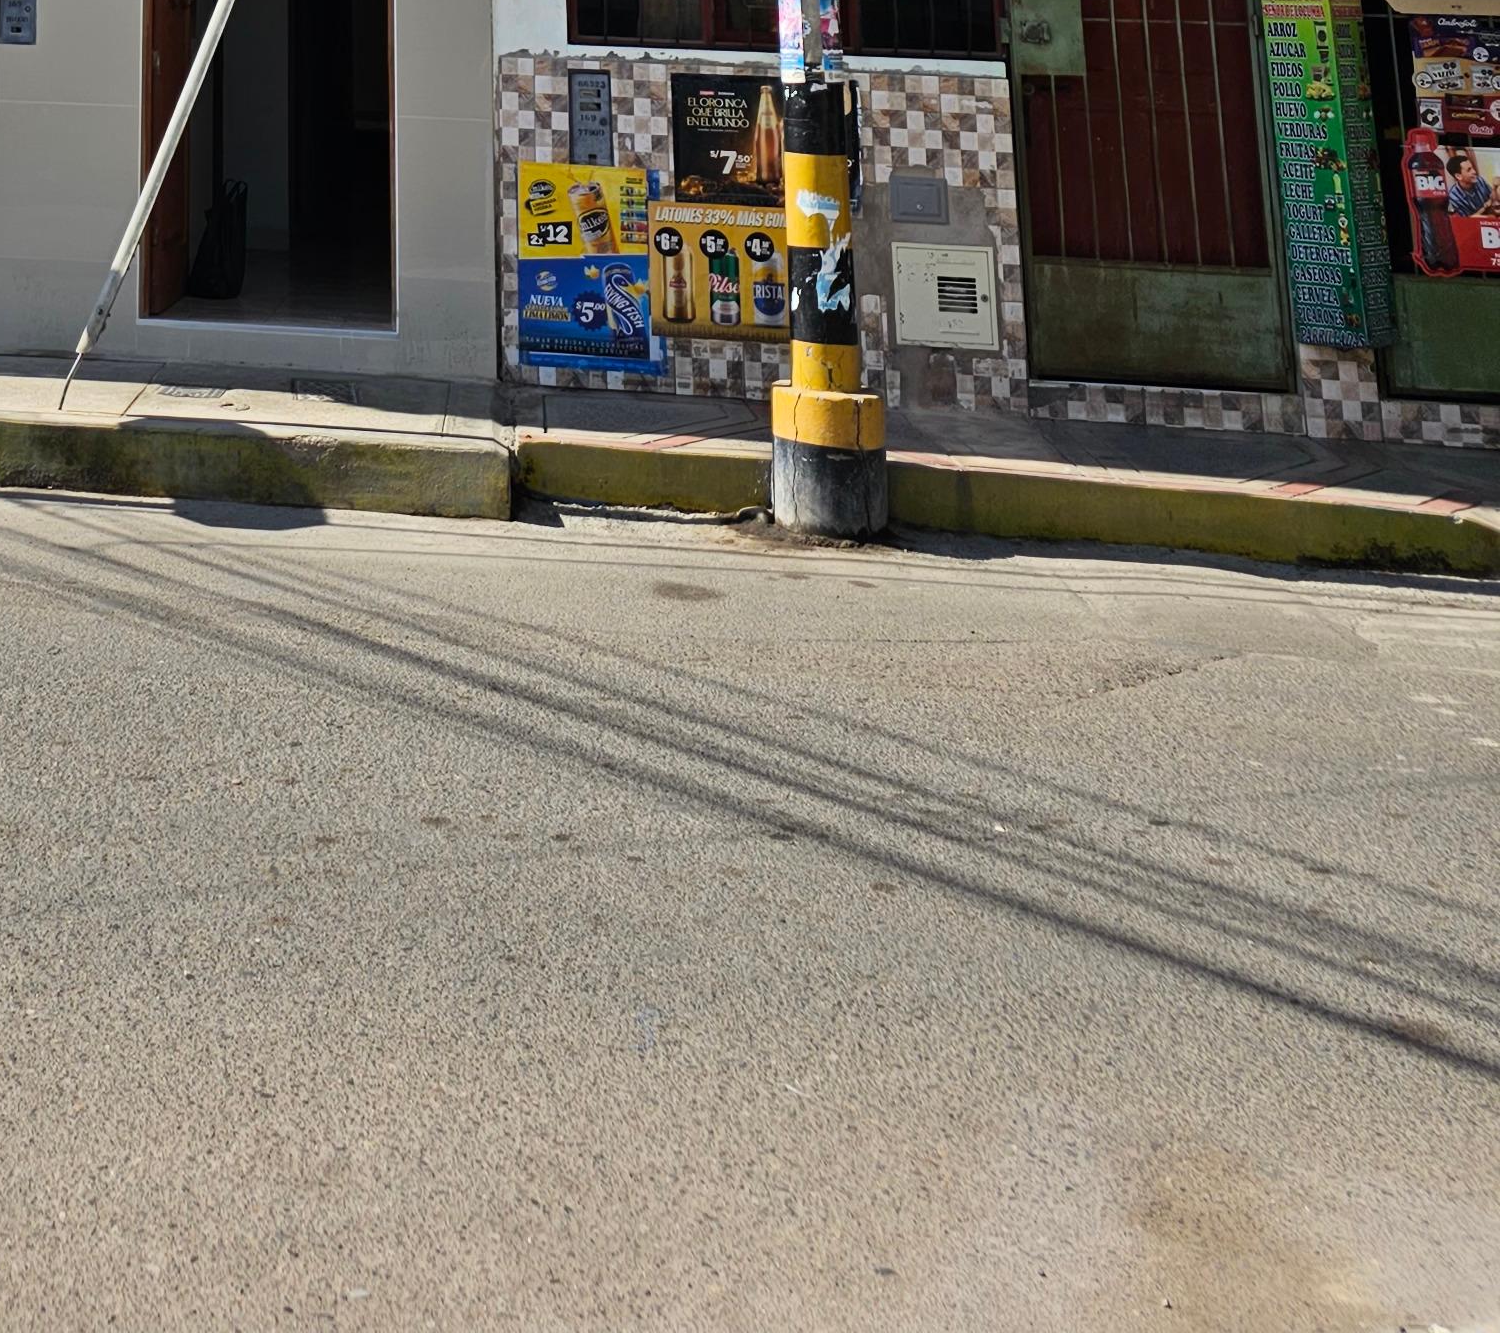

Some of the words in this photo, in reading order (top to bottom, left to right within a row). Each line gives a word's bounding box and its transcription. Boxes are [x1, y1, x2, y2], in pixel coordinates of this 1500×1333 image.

[1268, 23, 1297, 37] ARROZ
[1270, 42, 1306, 58] AZUCAR
[1272, 62, 1303, 77] FIDEOS
[1274, 82, 1301, 97] POLLO
[687, 97, 698, 107] EL
[700, 97, 723, 107] ORO
[724, 98, 748, 109] INCA
[1276, 102, 1306, 117] HUEVO
[692, 107, 713, 117] QUE
[714, 108, 744, 118] BRILLA
[686, 116, 699, 126] EN
[700, 117, 712, 127] EL
[712, 117, 750, 128] MUNDO
[1278, 122, 1327, 139] VERDURAS
[1280, 143, 1315, 159] FRUTAS
[1283, 163, 1315, 179] ACEITE
[1415, 175, 1447, 190] BIG
[1284, 184, 1313, 199] LECHE
[655, 208, 703, 224] LATONES
[705, 209, 735, 226] 33%
[736, 209, 764, 228] MÁS
[1286, 204, 1324, 220] YOGURT
[1289, 225, 1335, 242] GALLETAS
[1480, 226, 1500, 249] B
[1291, 245, 1352, 264] DETERGENTE
[1294, 266, 1342, 284] GASEOSAS
[530, 294, 563, 306] NUEVA
[1296, 286, 1339, 304] CERVEZA
[604, 283, 630, 309] FLYING
[622, 306, 645, 328] FISH
[1299, 307, 1345, 326] PICARONES
[1302, 327, 1366, 347] PARRILLADAS
